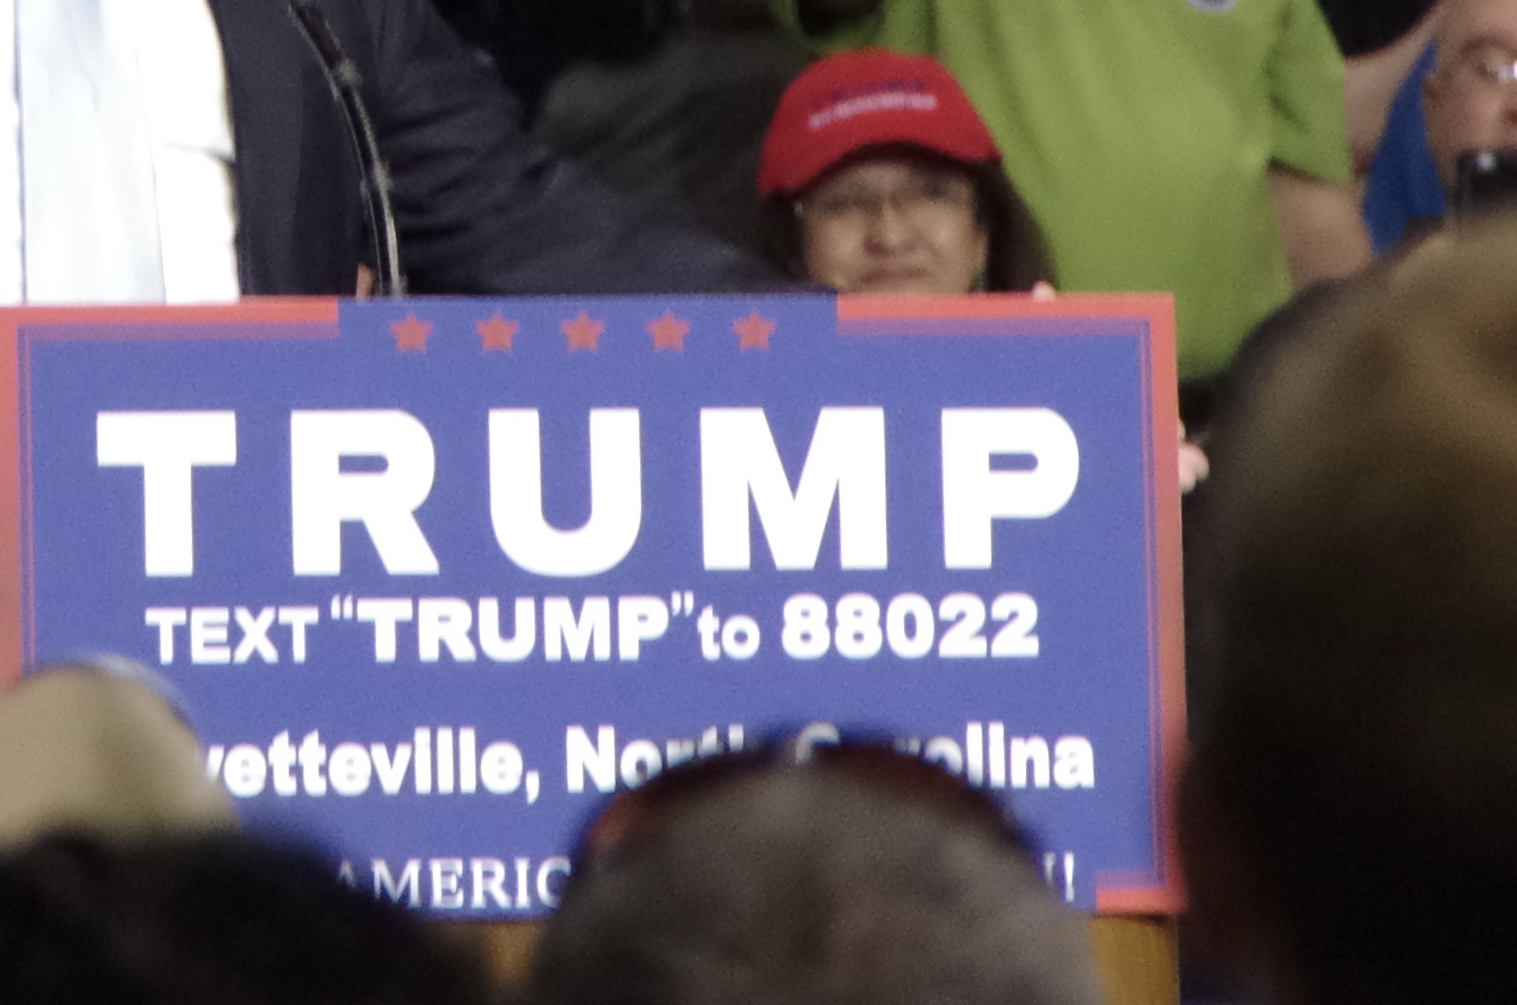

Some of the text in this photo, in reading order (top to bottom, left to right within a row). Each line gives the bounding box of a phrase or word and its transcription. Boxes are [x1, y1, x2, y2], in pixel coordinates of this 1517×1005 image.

[96, 406, 1080, 577] TRUMP
[144, 607, 319, 665] TEXT
[697, 604, 760, 660] to
[782, 593, 1039, 659] 88022
[206, 726, 540, 804] etteville,
[340, 856, 572, 910] MERIC
